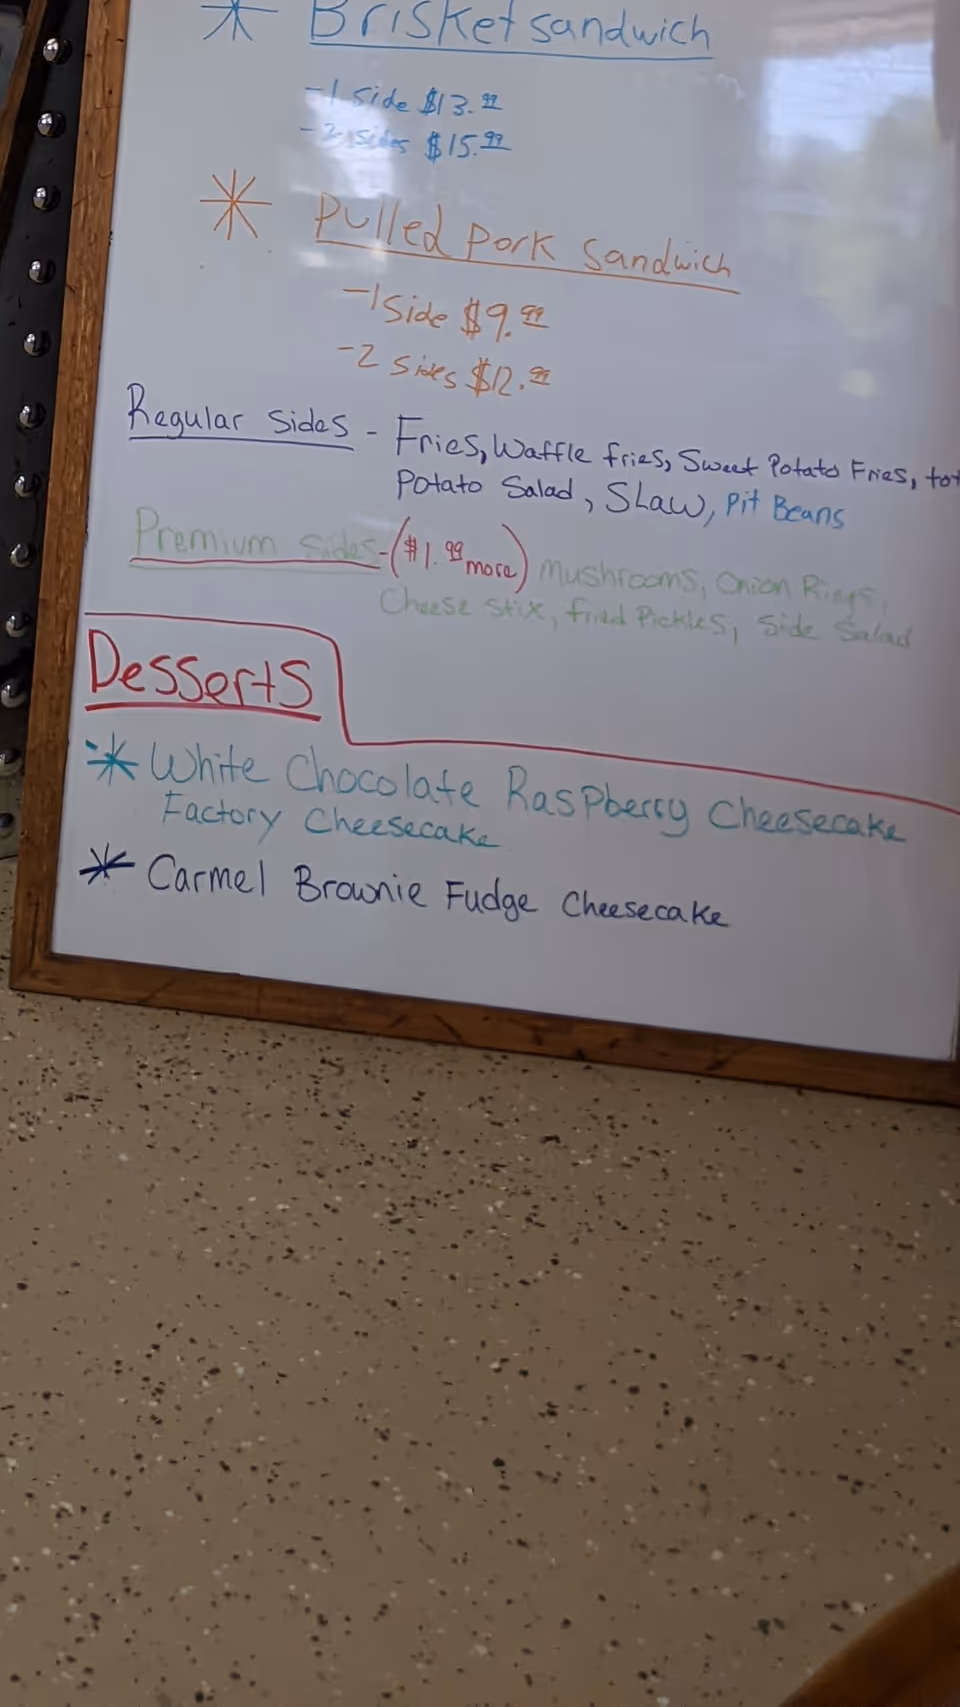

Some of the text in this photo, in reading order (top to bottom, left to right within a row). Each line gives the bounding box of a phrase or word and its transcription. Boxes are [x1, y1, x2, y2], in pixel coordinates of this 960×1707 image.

[531, 7, 711, 51] sandwich
[314, 191, 452, 259] Pulled
[466, 222, 556, 262] Pork
[127, 382, 244, 439] Regular
[268, 407, 350, 438] Sides
[678, 448, 759, 477] Sweet
[767, 453, 841, 479] Potato
[851, 459, 917, 491] Fries,
[396, 468, 483, 501] Potato
[773, 494, 846, 530] Beans
[135, 505, 277, 557] Premium
[716, 570, 790, 597] Onion
[379, 585, 473, 618] Cheese
[150, 741, 271, 787] White
[286, 745, 482, 809] Chocolate
[708, 794, 907, 844] Cheesecake
[161, 793, 502, 849] Factory Cheesecake
[147, 853, 732, 930] Carmel Brownie Fudge Cheesecake
